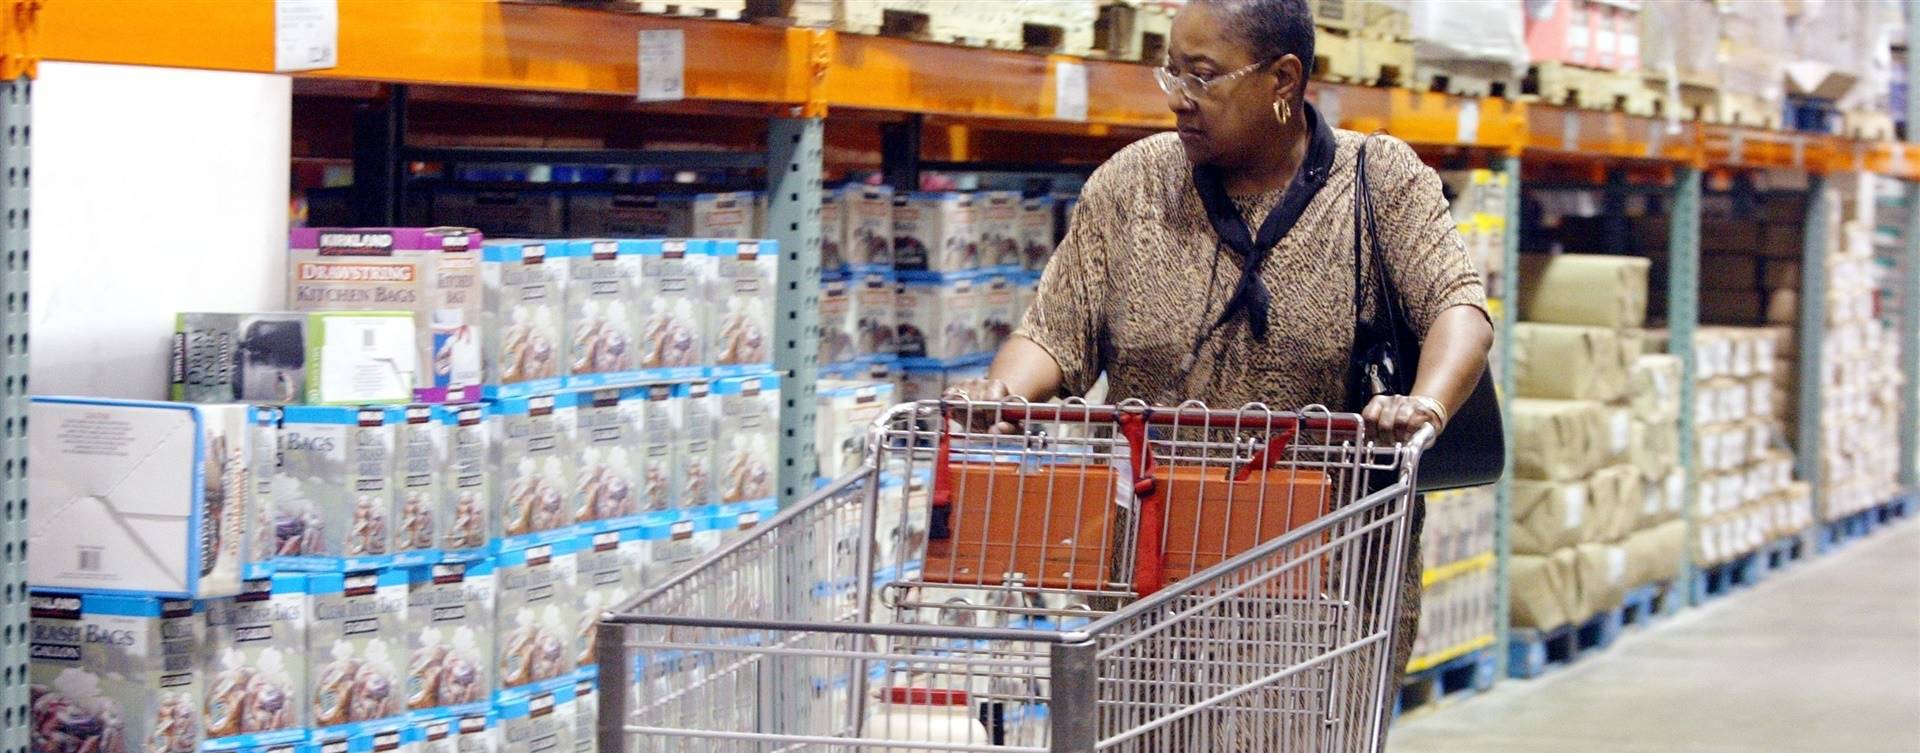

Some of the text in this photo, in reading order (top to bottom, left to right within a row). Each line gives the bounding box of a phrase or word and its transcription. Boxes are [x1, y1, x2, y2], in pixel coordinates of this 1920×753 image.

[320, 233, 393, 248] KIRKLAND
[302, 264, 412, 281] DRAWSTRING
[297, 286, 417, 303] KITCHEN BAGS
[287, 432, 336, 452] BAGS
[31, 622, 135, 646] RASH BAGS
